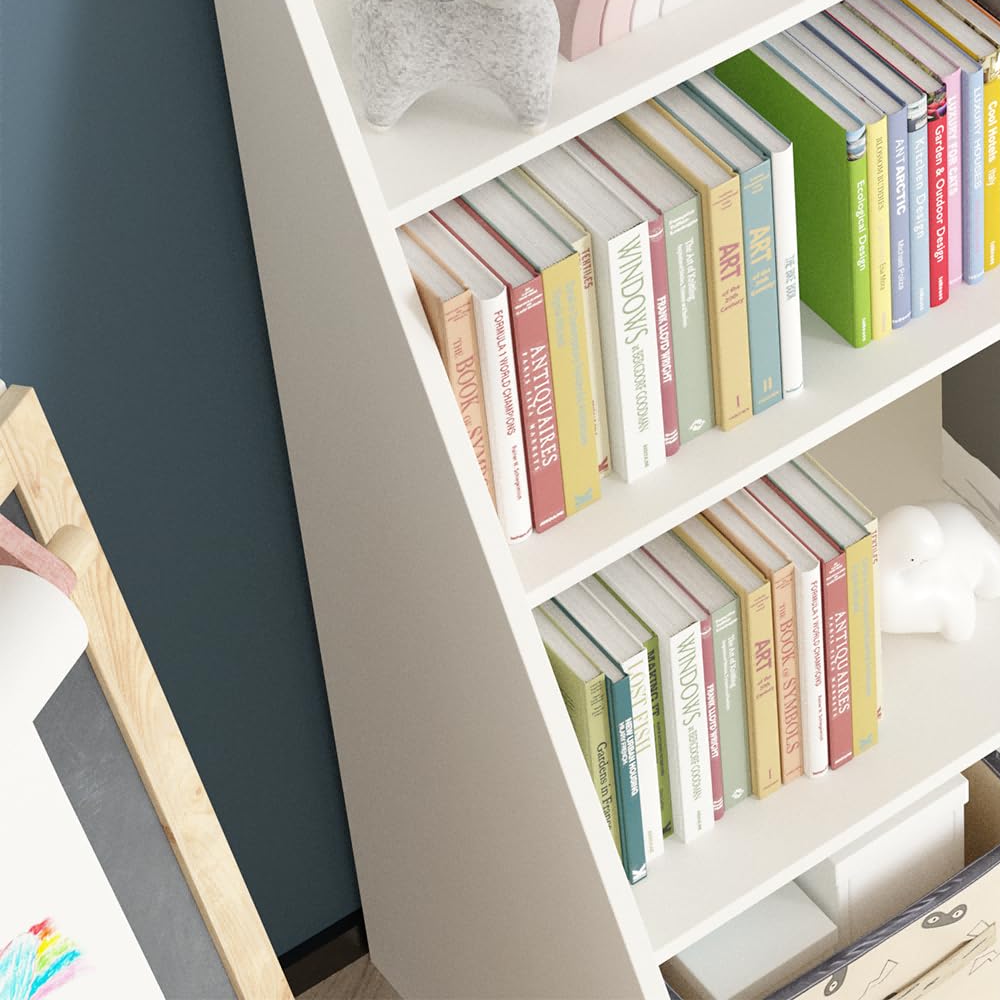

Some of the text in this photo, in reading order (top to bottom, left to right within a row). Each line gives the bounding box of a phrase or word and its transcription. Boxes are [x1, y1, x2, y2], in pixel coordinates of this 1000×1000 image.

[895, 139, 906, 215] ANTARCTIC
[947, 96, 959, 196] LUXURY FOR CATS
[973, 87, 983, 190] LUXURY HOUSES
[986, 100, 998, 187] Cool Hotels Italy
[855, 180, 868, 272] Ecological Design
[913, 138, 926, 240] Kitchen Design
[933, 124, 946, 263] Garden & Outdoor Design
[718, 240, 742, 281] ART
[748, 225, 773, 265] ART
[618, 234, 649, 345] WINDOWS
[656, 295, 667, 323] FRANK
[453, 339, 464, 356] THE
[495, 309, 507, 349] FORMULA
[455, 354, 480, 414] BOOK
[499, 356, 512, 387] WORLD
[529, 342, 558, 468] ANTIQUAIRES
[660, 351, 672, 385] WRIGHT
[501, 387, 516, 436] CHAMPIONS
[676, 632, 701, 726] WINDOWS
[755, 639, 772, 672] ART
[779, 617, 796, 665] BOOK
[834, 611, 851, 714] ANTIQUAIRES
[628, 658, 651, 754] LOST FISH
[782, 677, 801, 755] SYMBOLS
[596, 741, 611, 796] Gardens in
[625, 717, 639, 797] NEW URBAN HOUSING
